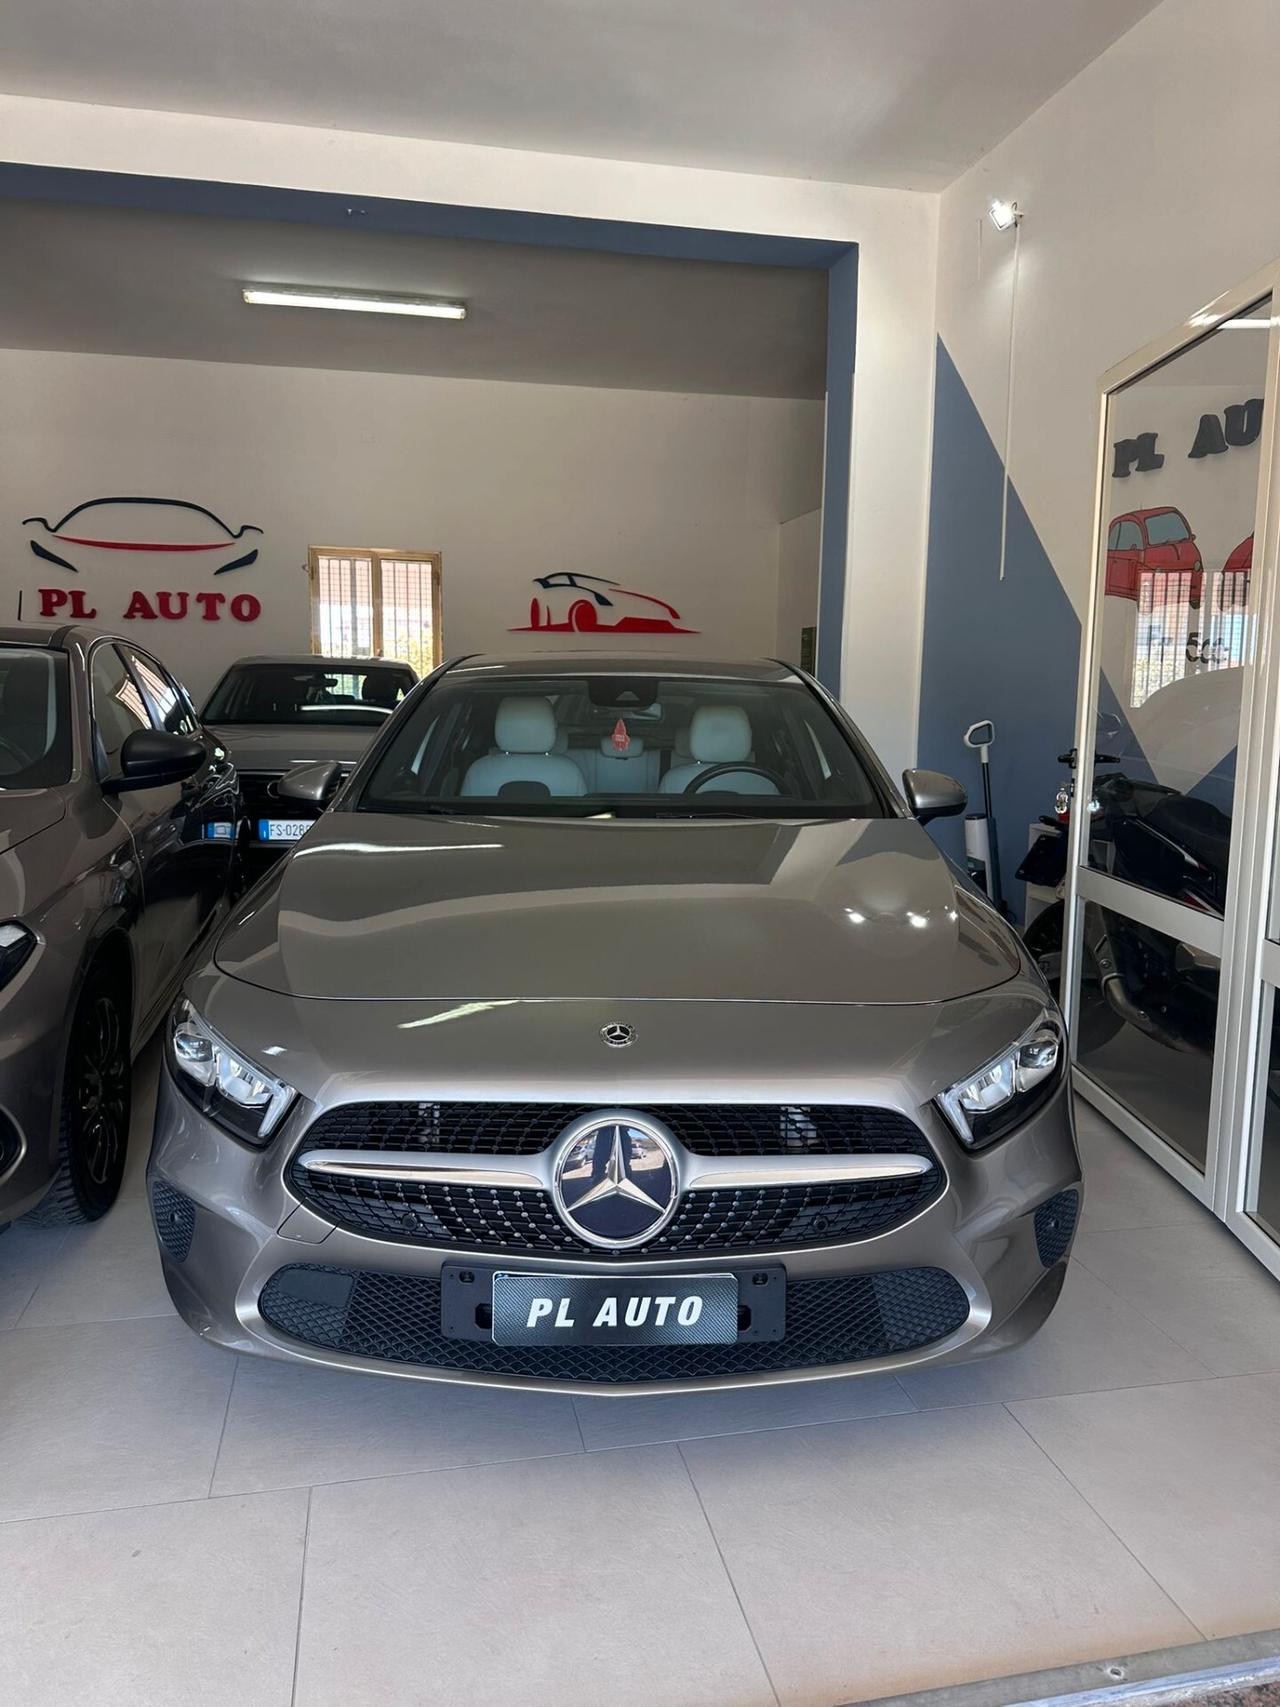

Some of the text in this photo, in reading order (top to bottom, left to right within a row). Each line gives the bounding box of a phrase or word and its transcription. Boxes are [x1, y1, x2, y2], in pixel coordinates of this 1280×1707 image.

[1112, 432, 1165, 477] PL
[39, 588, 262, 622] PL AUTO
[526, 1296, 703, 1328] PL AUTO
